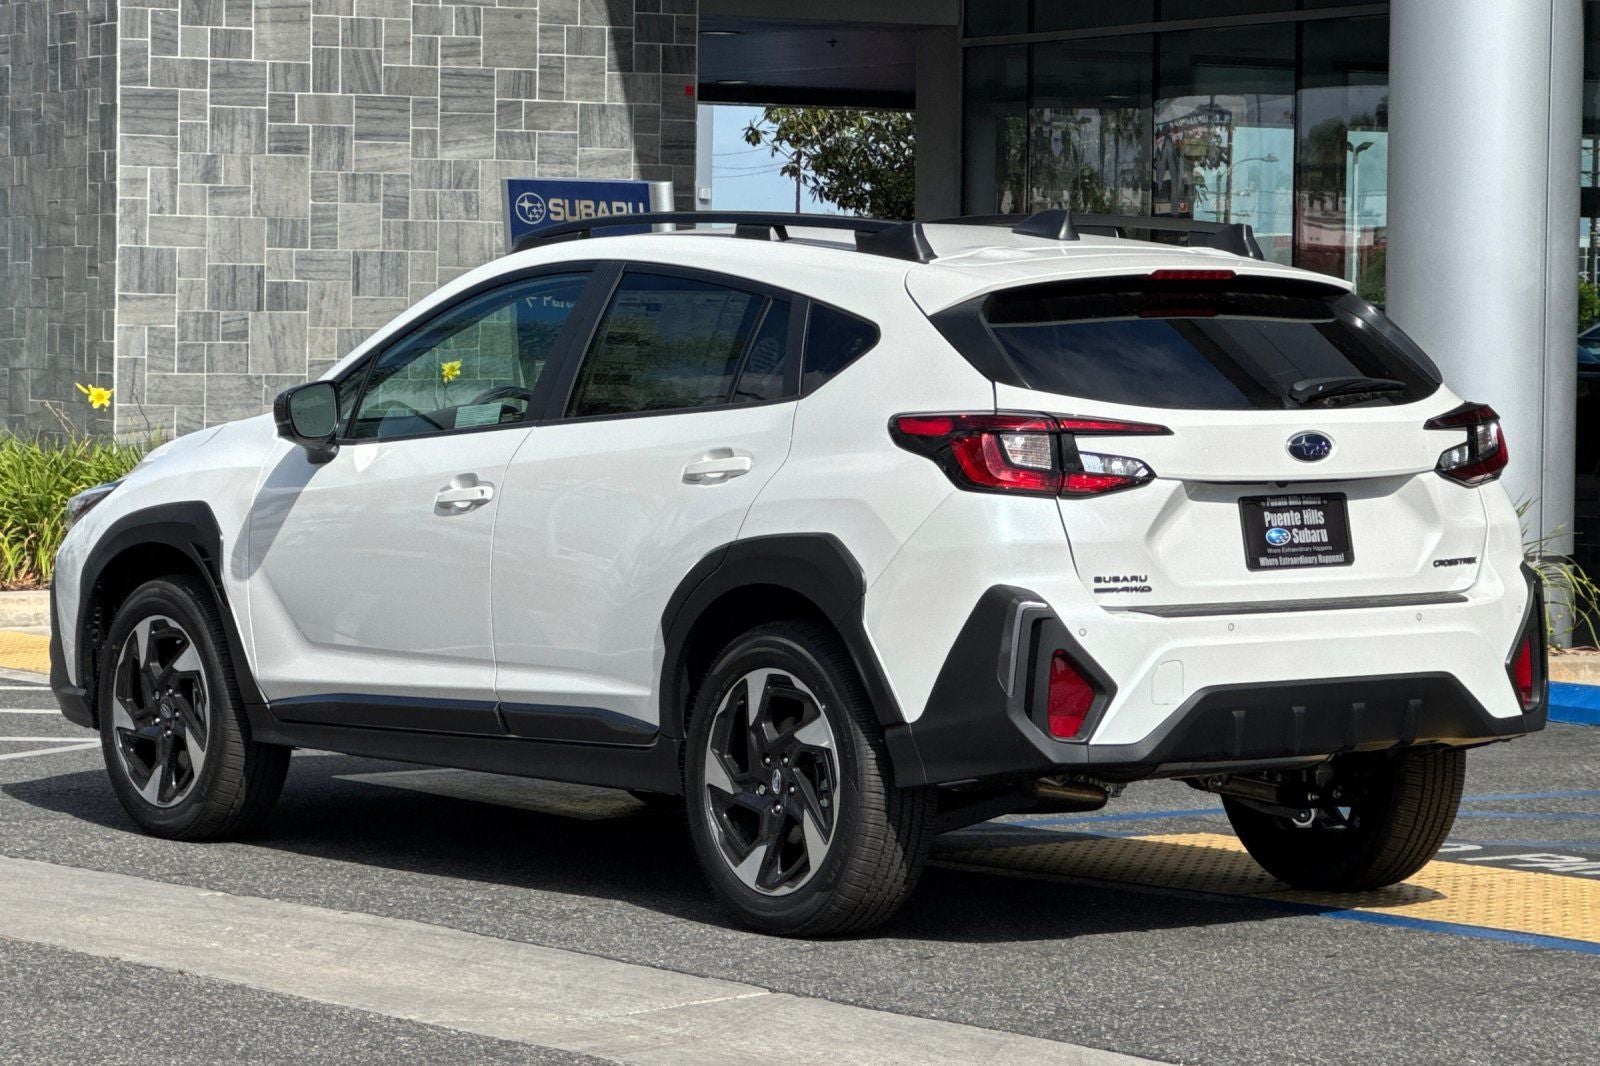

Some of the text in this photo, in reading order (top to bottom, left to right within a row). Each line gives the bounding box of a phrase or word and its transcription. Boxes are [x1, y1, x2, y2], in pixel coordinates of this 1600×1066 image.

[1264, 508, 1325, 527] Puente Hills
[1292, 528, 1329, 543] Subaru
[1259, 556, 1279, 566] Where
[1279, 554, 1318, 565] Extraordinary
[1094, 575, 1148, 583] SUBARU
